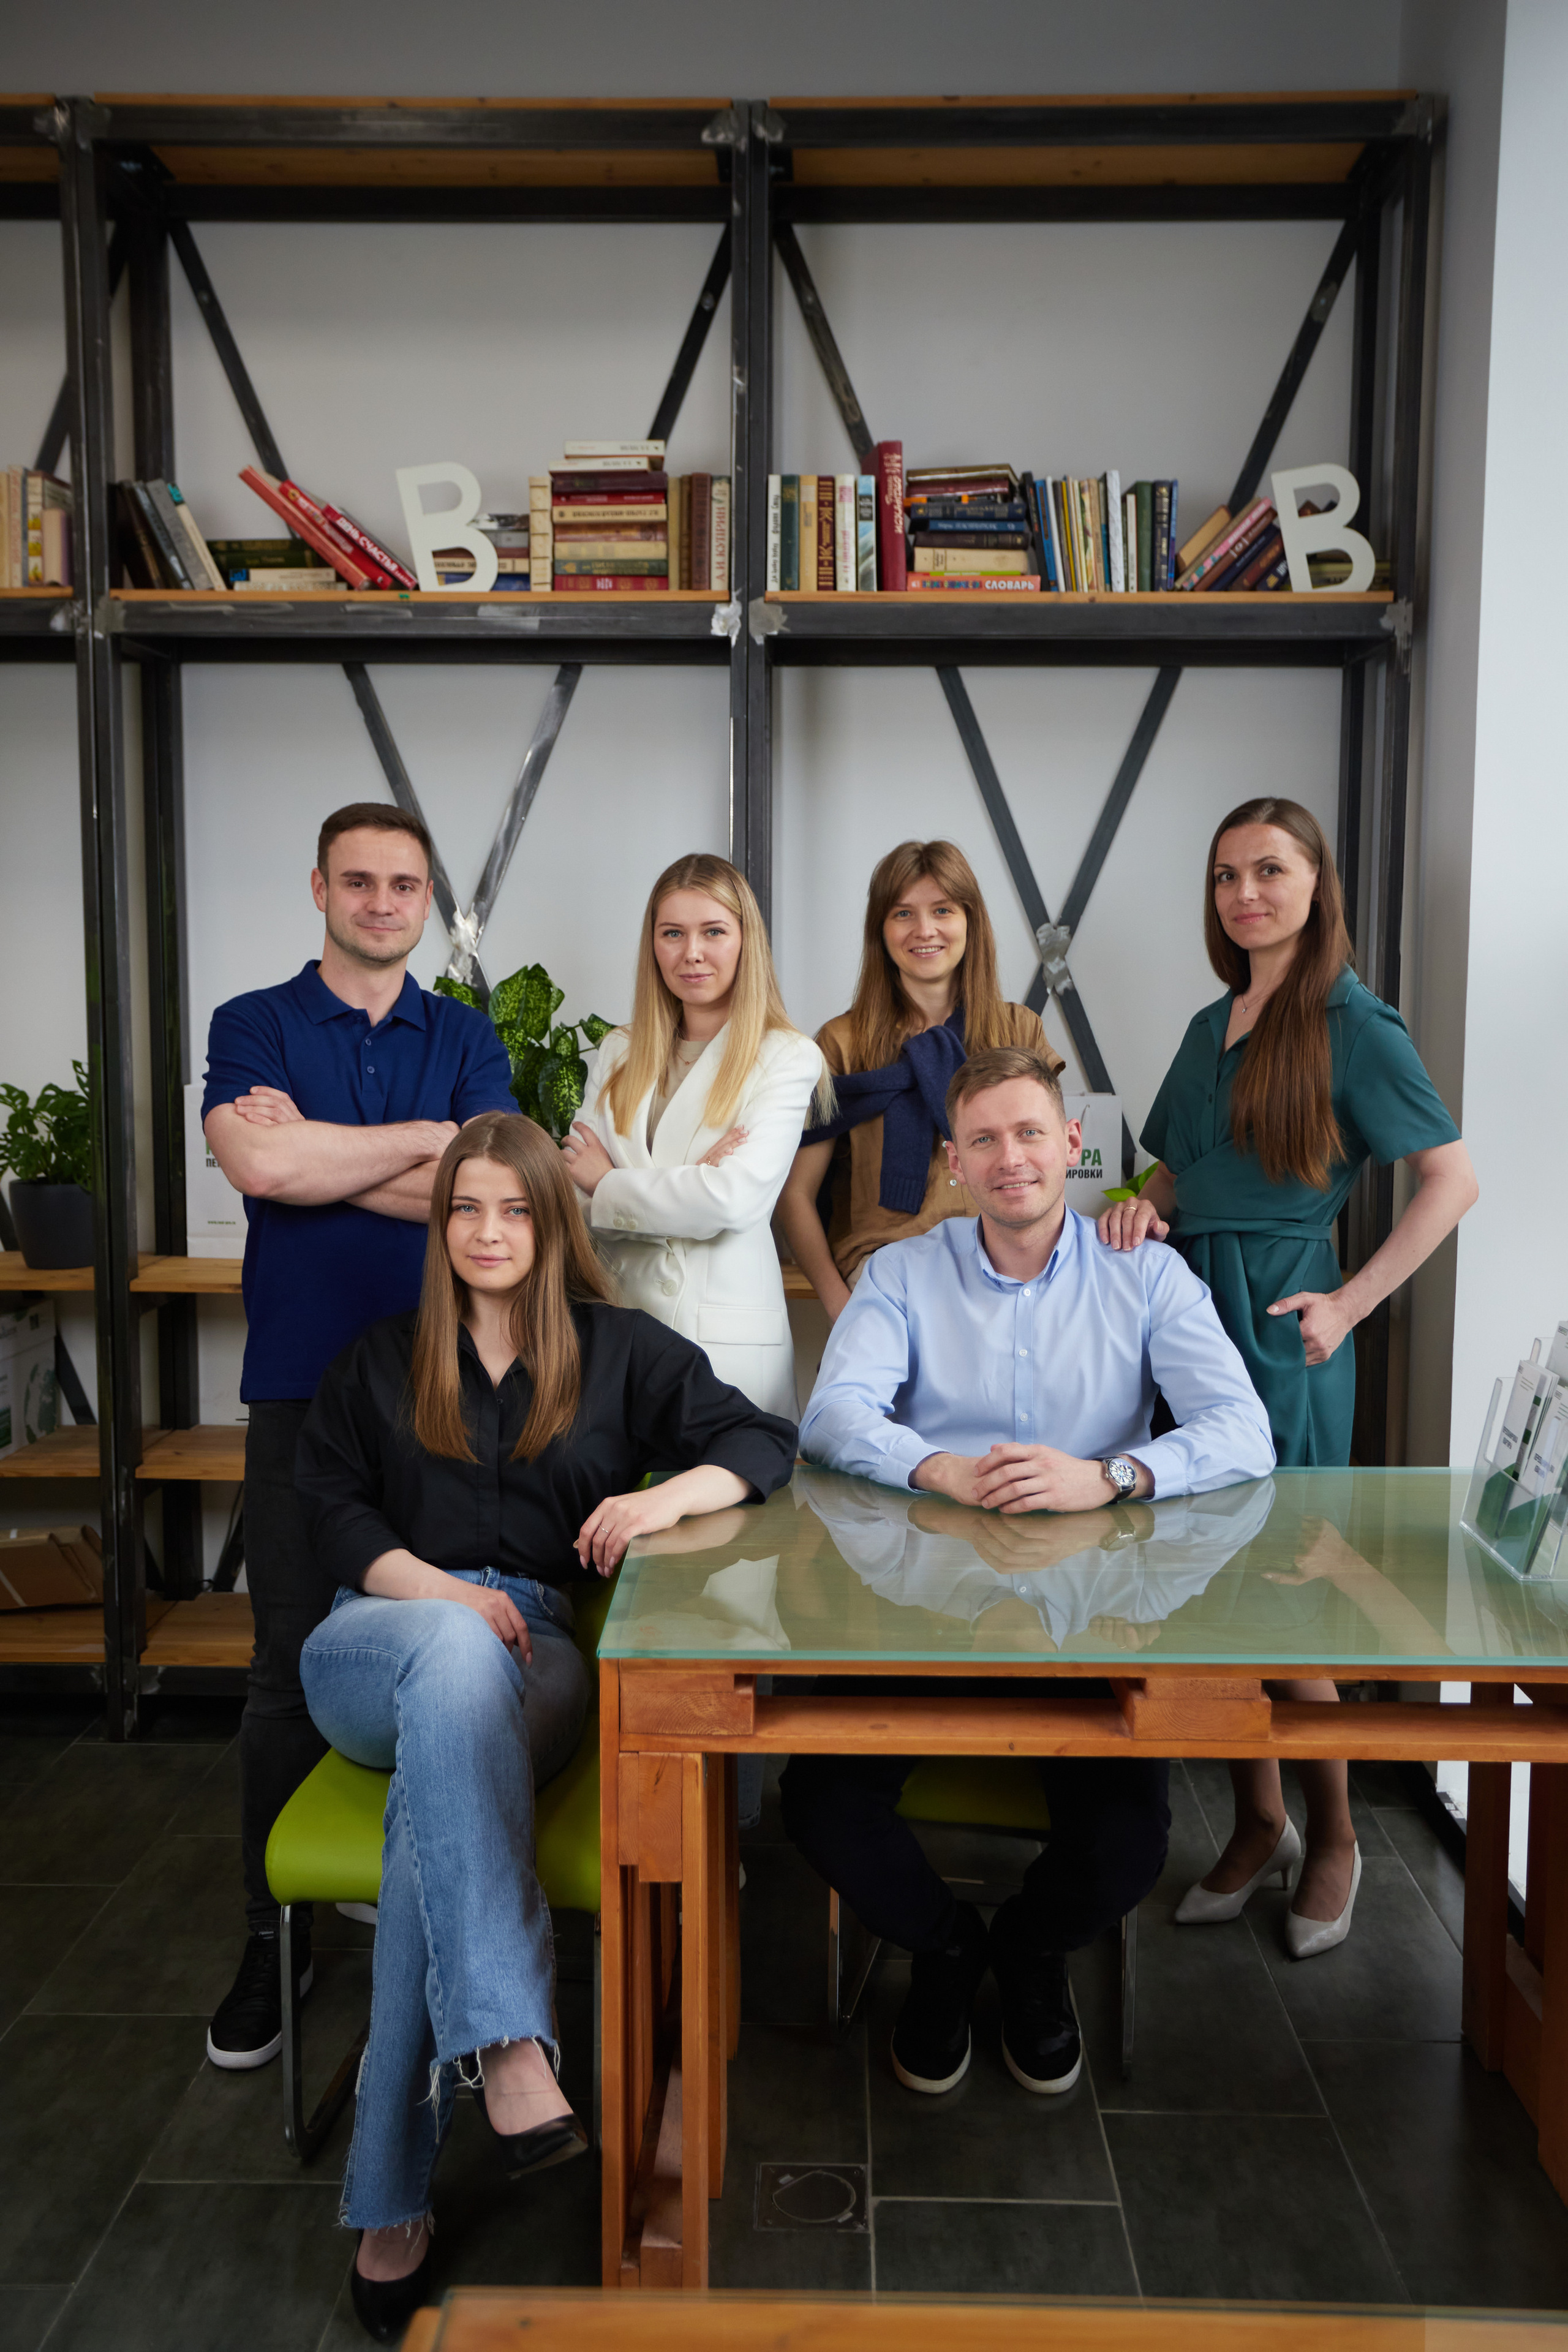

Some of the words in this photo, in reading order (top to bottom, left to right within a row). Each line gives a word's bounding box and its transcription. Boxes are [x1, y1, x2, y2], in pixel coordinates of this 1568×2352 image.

[336, 517, 360, 540] ДЕНЬ
[359, 534, 399, 571] СЧАСТЬЯ
[715, 506, 726, 559] КУПРИН
[984, 579, 1035, 590] СЛОВАРЬ
